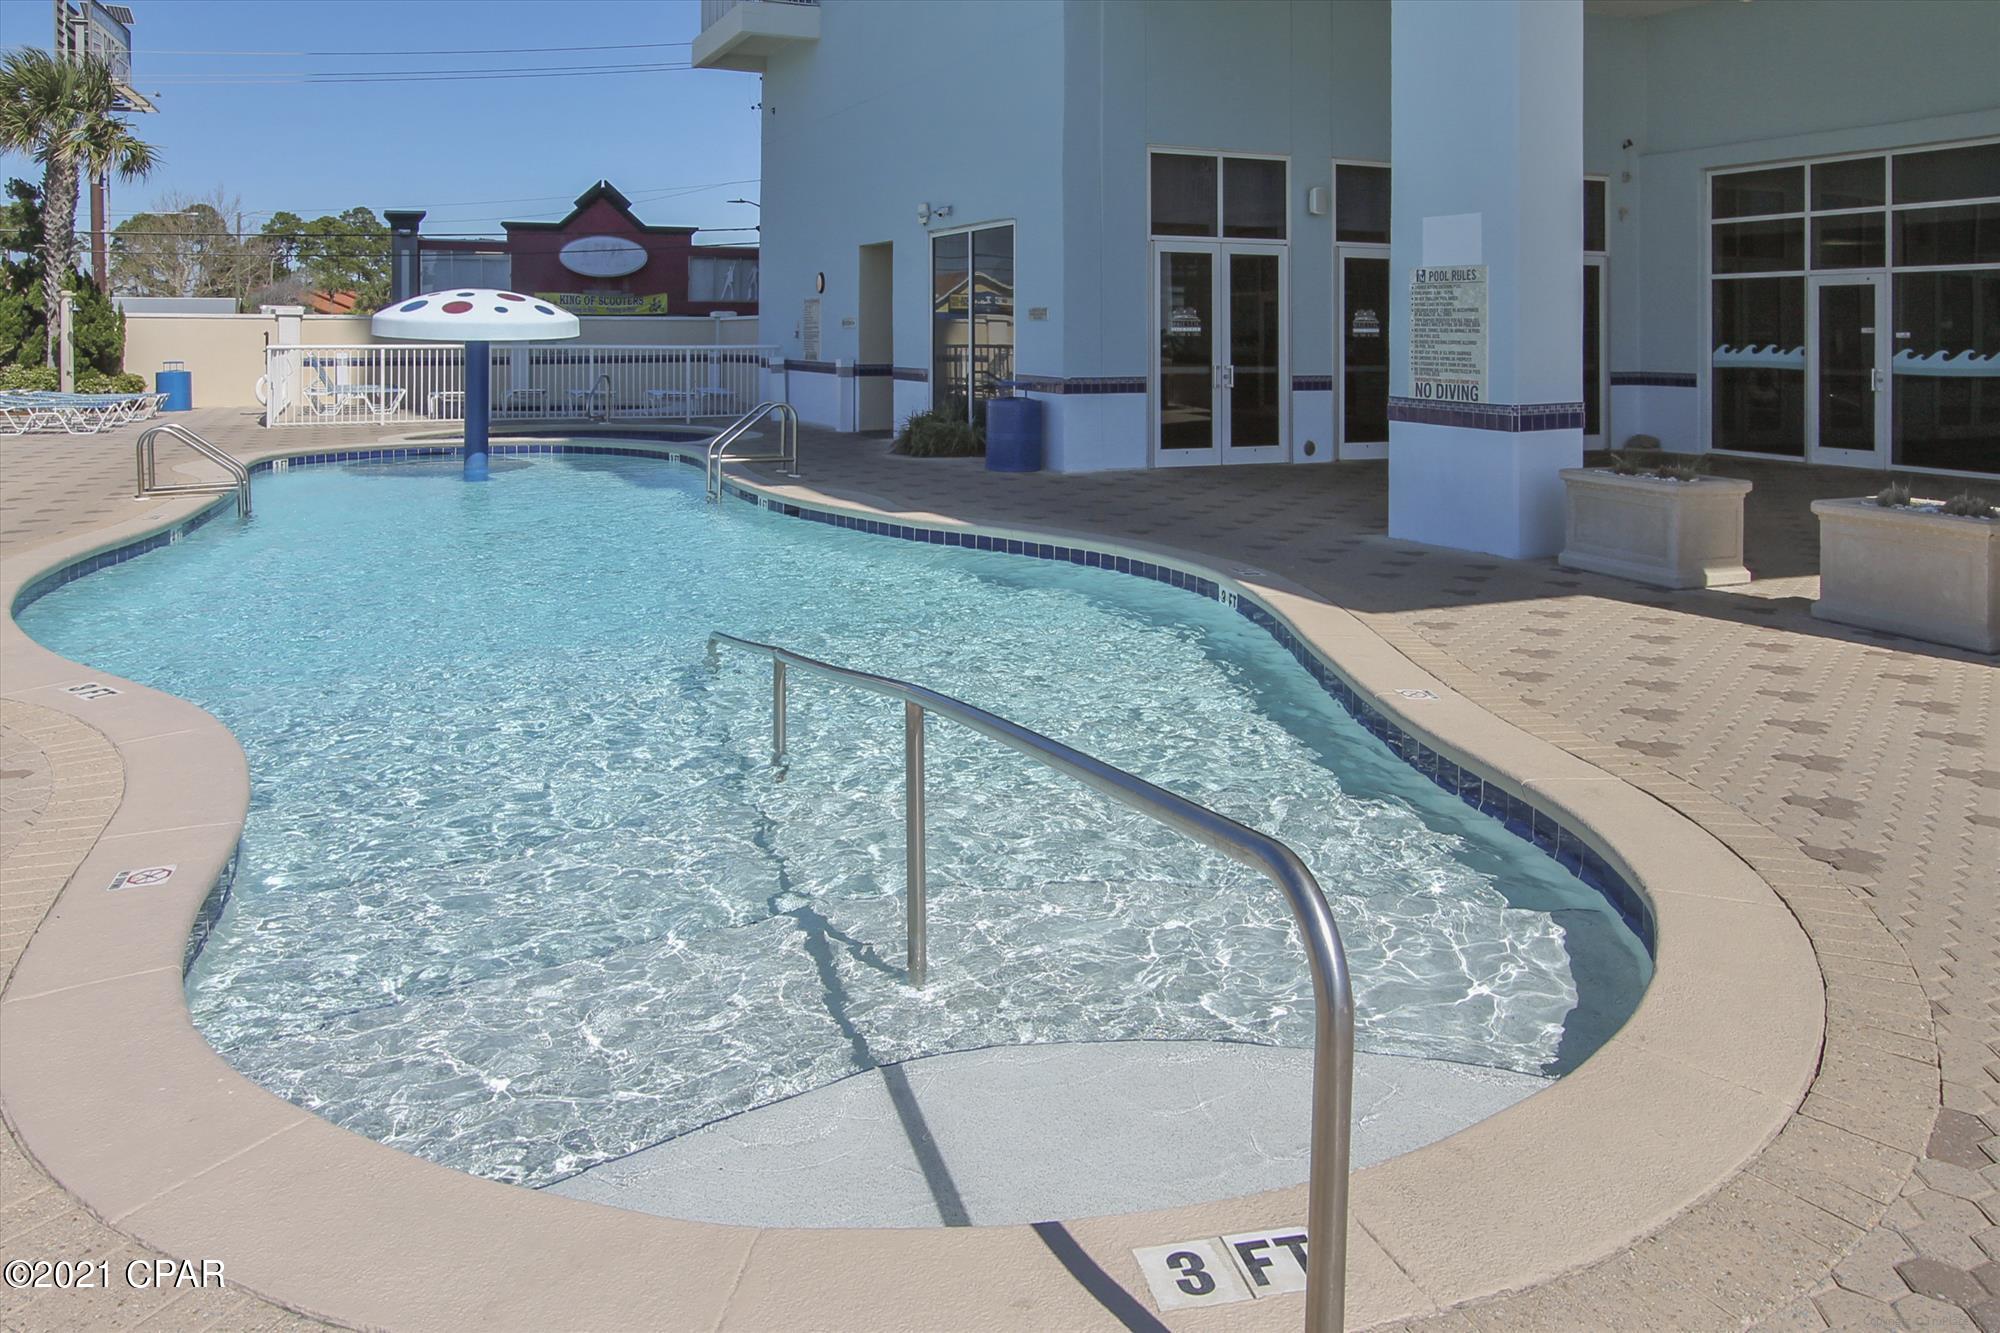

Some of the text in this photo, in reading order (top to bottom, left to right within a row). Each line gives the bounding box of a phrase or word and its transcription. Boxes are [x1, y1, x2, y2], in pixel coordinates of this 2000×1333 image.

[1428, 268, 1477, 282] POOL RULES
[559, 294, 644, 306] KING OF SCOOTERS
[1415, 382, 1479, 402] NO DIVING
[1165, 1233, 1308, 1296] 3 FT
